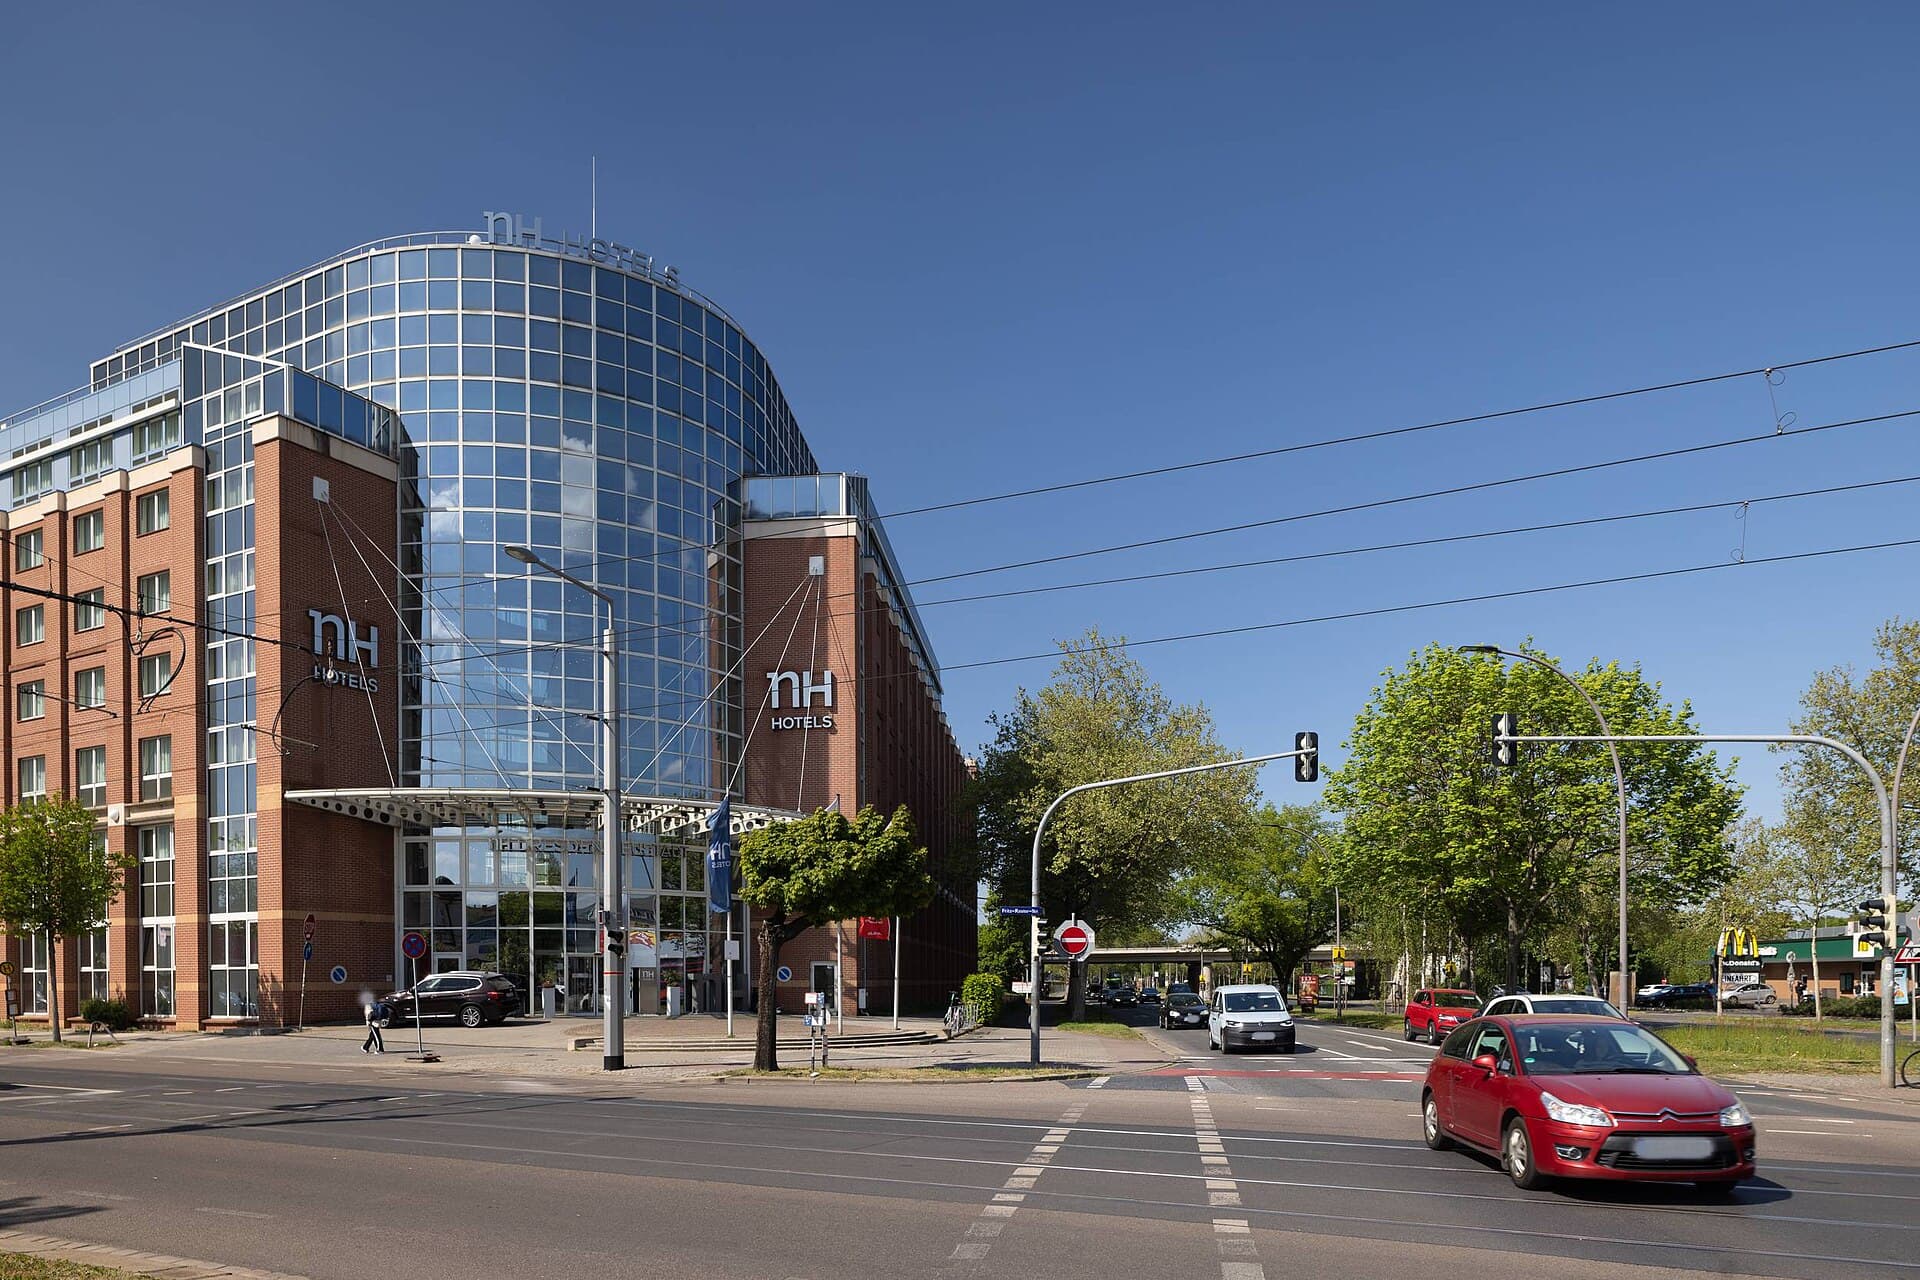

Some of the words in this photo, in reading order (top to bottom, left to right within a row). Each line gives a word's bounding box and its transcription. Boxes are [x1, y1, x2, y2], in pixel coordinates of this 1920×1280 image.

[562, 229, 680, 290] HOTELS
[314, 664, 378, 693] HOTELS
[771, 715, 832, 729] HOTELS
